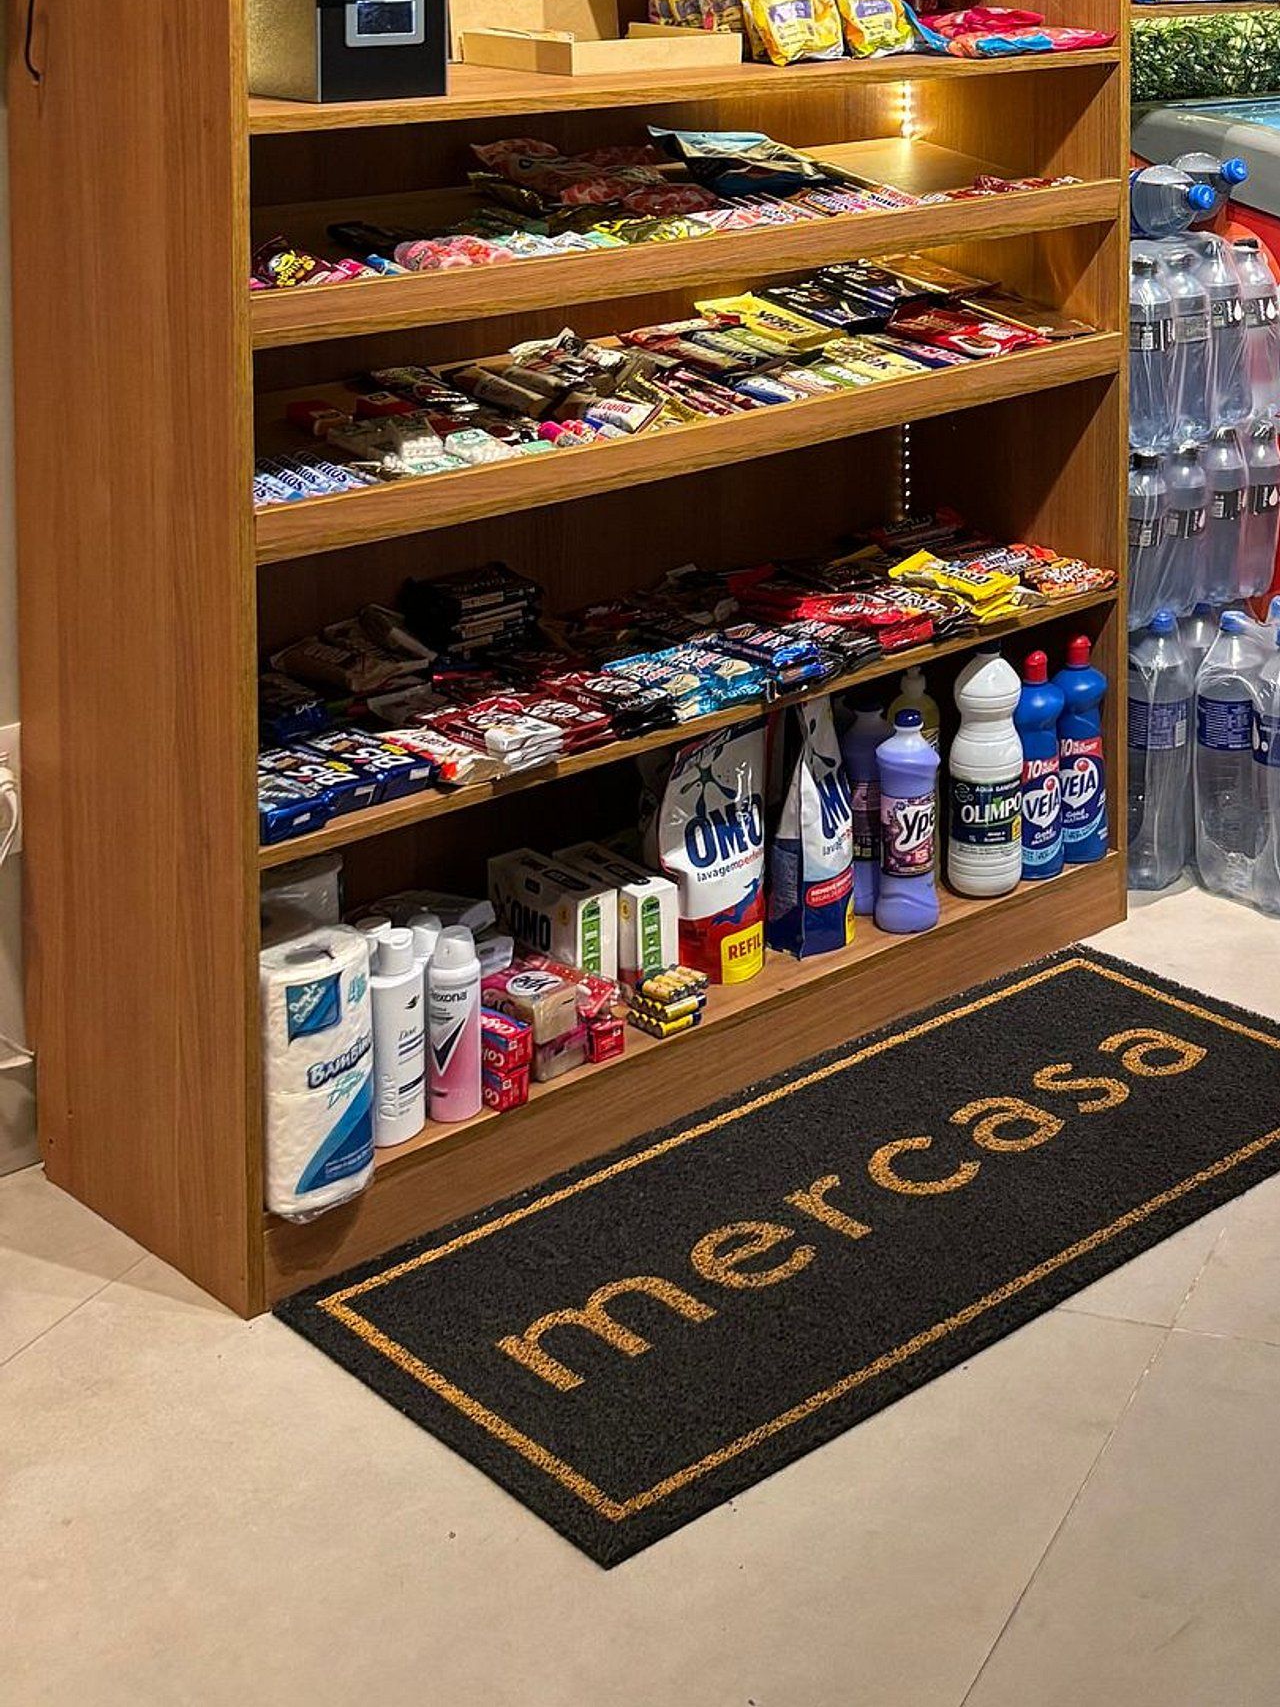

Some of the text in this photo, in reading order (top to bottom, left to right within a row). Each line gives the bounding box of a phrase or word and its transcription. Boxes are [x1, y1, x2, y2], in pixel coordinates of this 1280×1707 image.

[1025, 783, 1061, 820] VEJA
[1060, 769, 1098, 799] VEJA
[960, 791, 1022, 826] OLIMPO
[684, 793, 764, 869] OMO
[727, 932, 763, 961] REFIL
[494, 1026, 1209, 1395] mercasa
